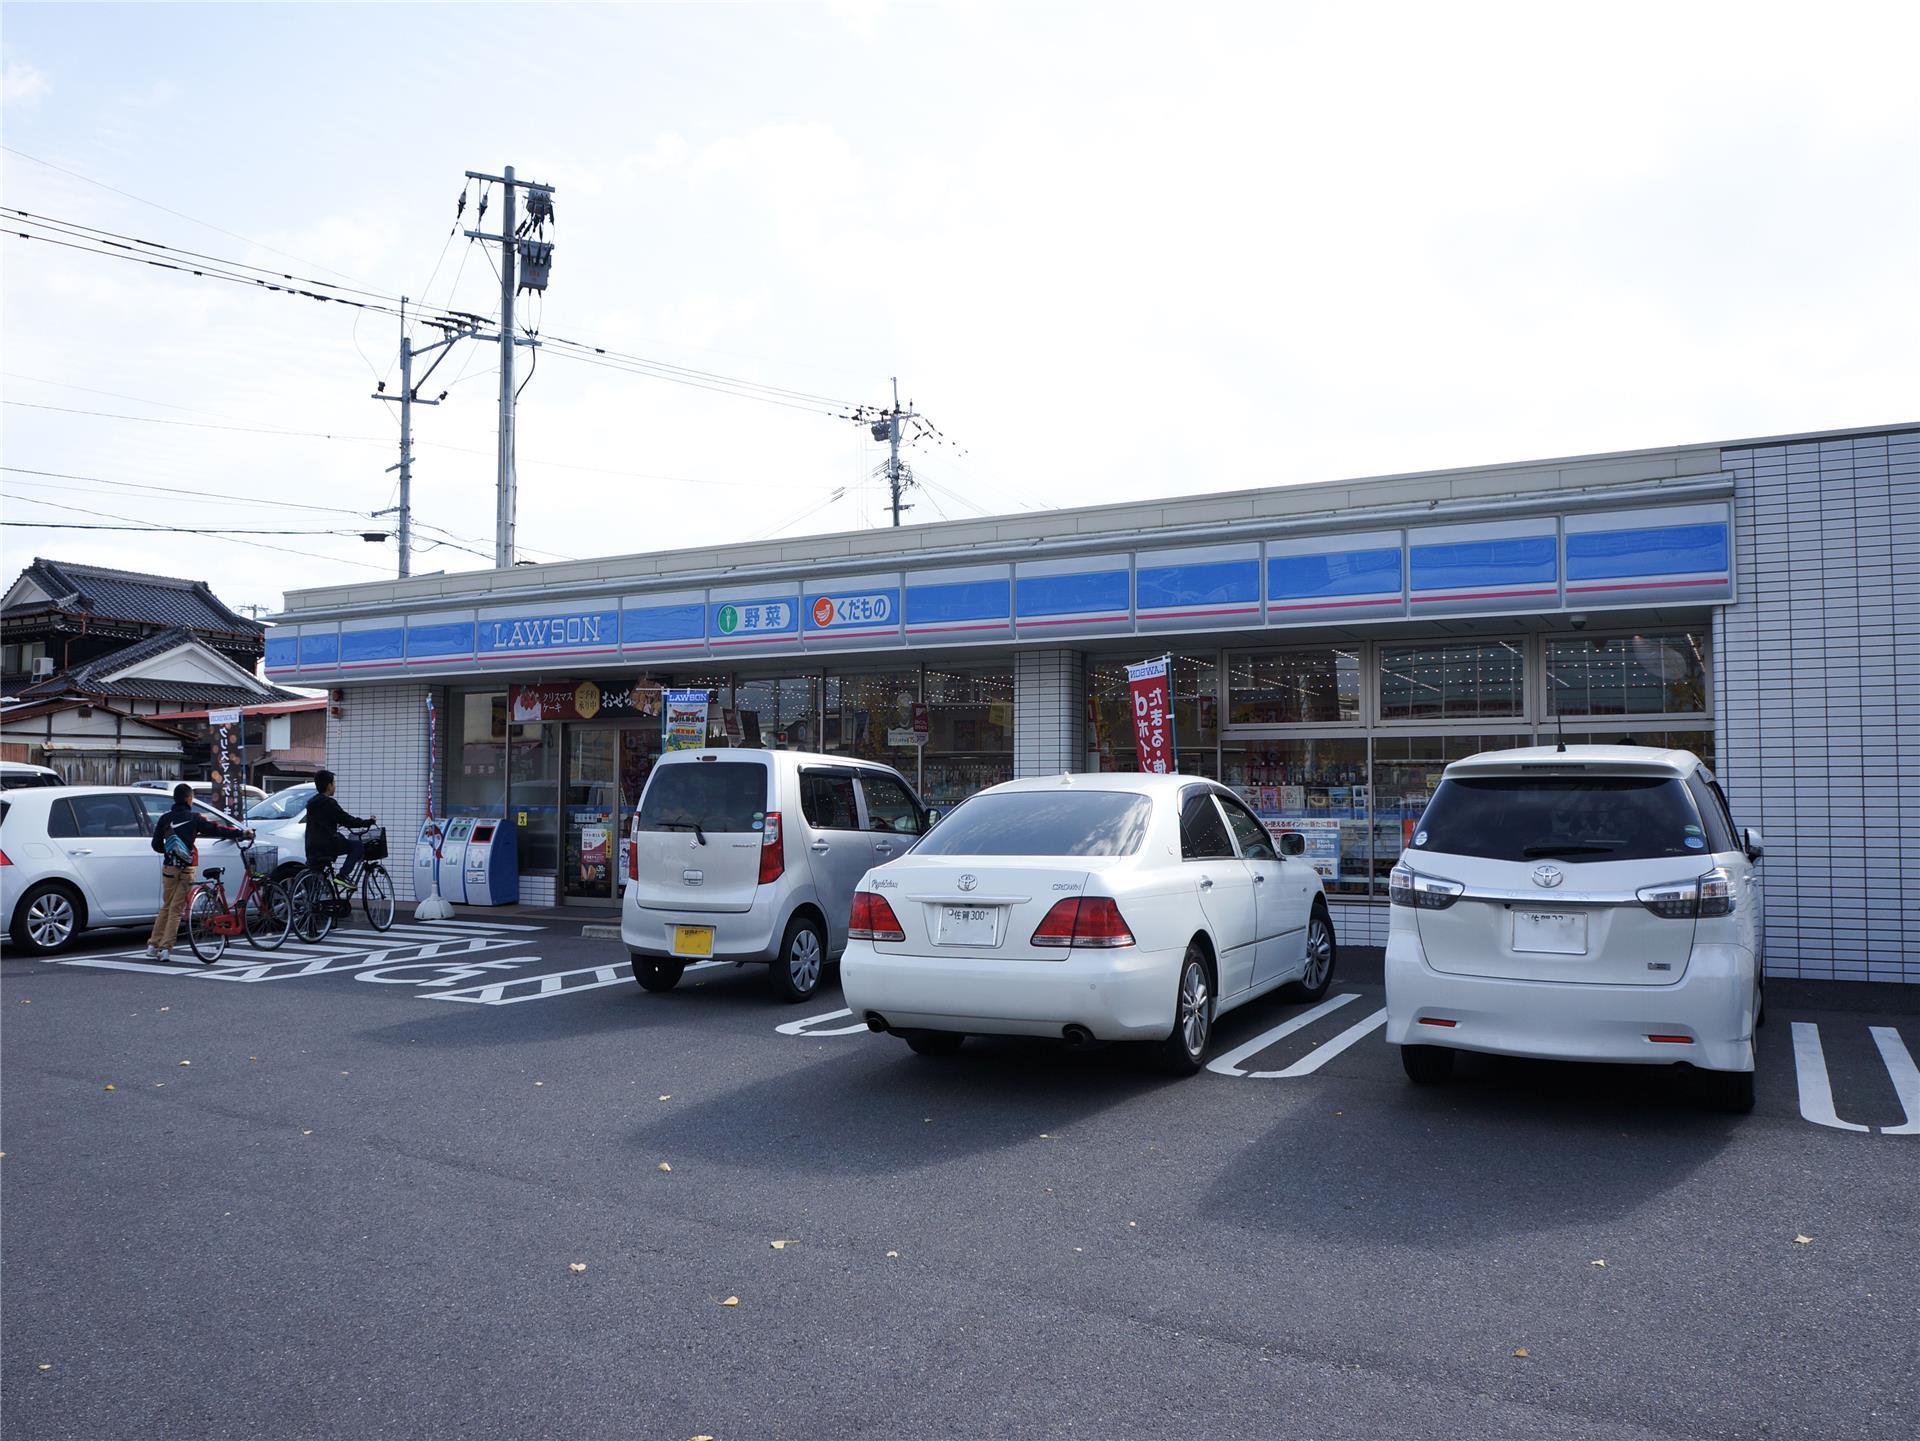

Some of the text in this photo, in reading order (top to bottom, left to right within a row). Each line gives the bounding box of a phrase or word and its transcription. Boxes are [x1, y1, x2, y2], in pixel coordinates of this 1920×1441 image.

[744, 606, 781, 628] 野菜
[837, 599, 886, 621] くだもの
[494, 616, 600, 647] LAWSON
[542, 692, 573, 702] クリスマス
[542, 702, 563, 713] ケーキ
[602, 688, 634, 709] おせち
[669, 693, 708, 702] LAWSON
